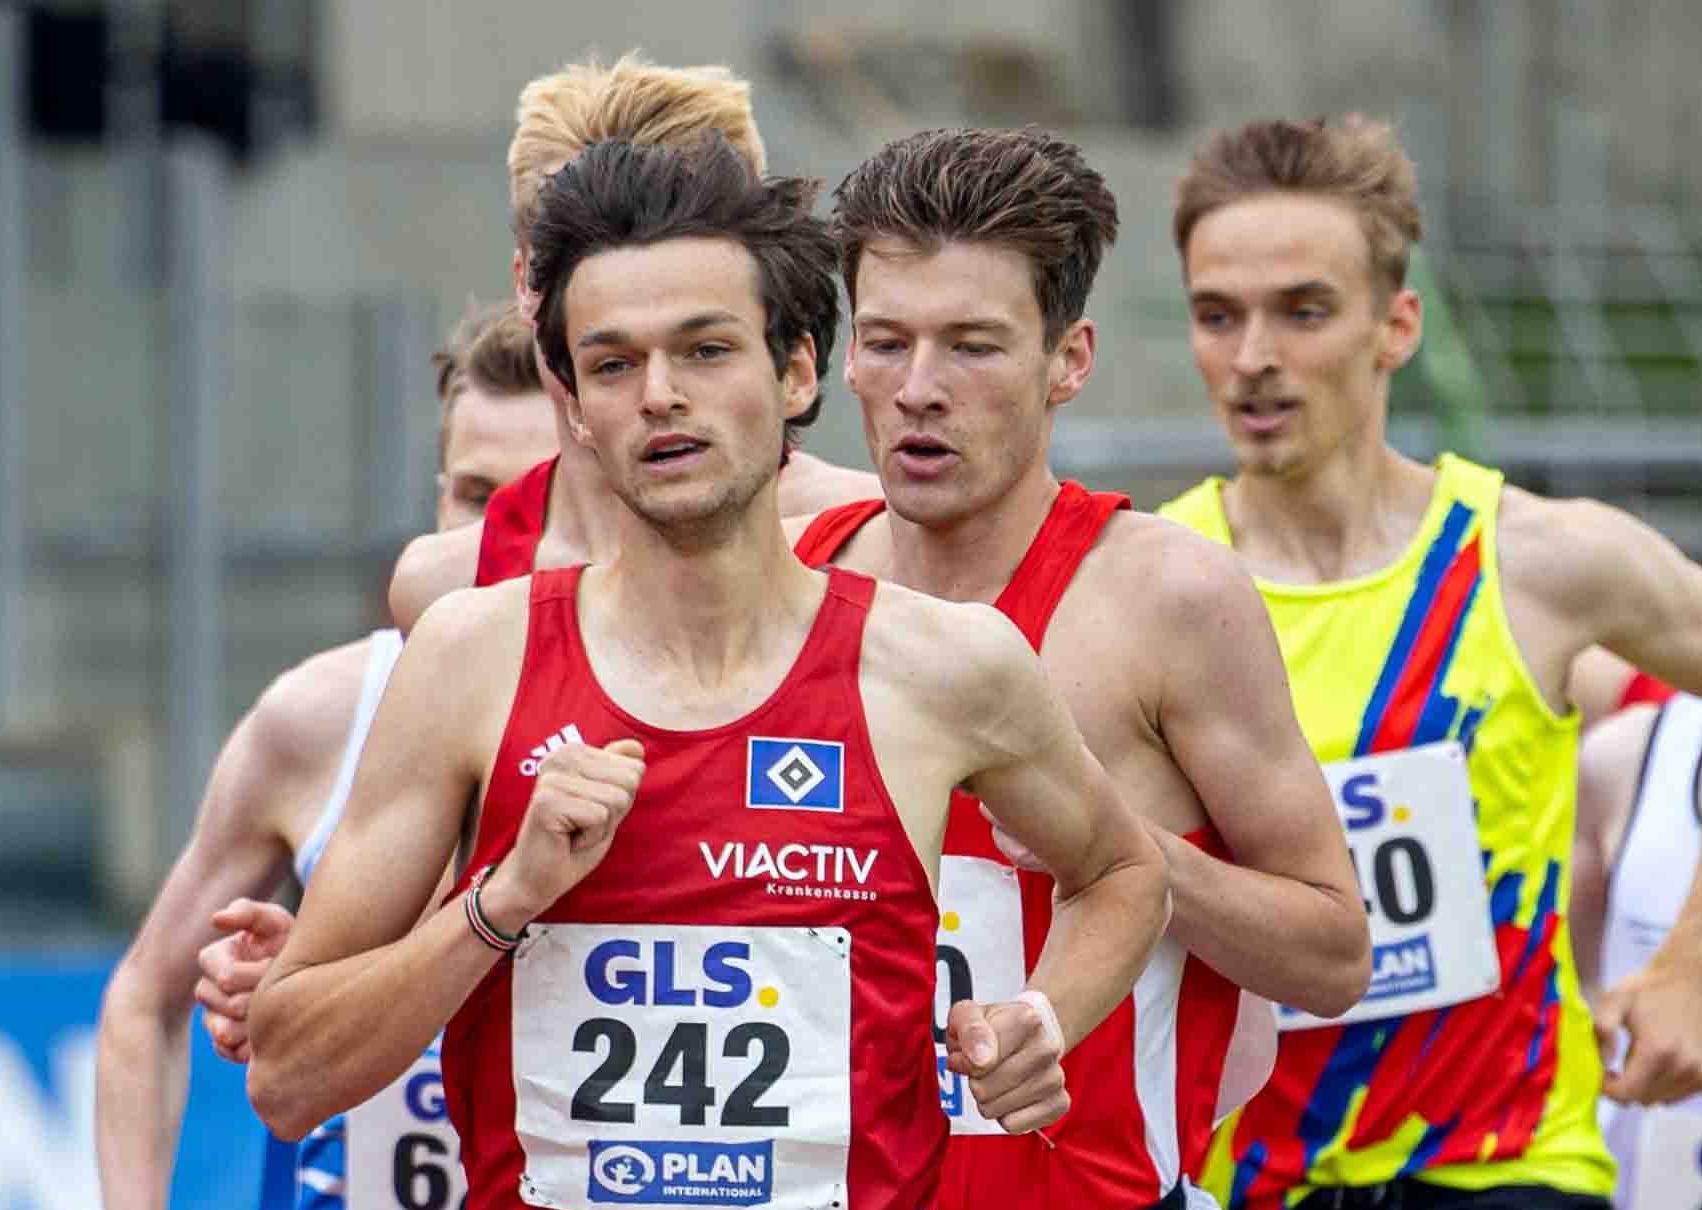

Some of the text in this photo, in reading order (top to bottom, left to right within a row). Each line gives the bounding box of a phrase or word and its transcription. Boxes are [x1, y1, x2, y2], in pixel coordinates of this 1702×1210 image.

[699, 841, 879, 885] VIACTIV
[1349, 836, 1436, 926] 0
[766, 881, 878, 901] Krankenkasse
[584, 939, 779, 1009] GLS.
[570, 1017, 791, 1128] 242
[662, 1152, 766, 1184] PLAN
[663, 1184, 763, 1198] INTERNATIONAL
